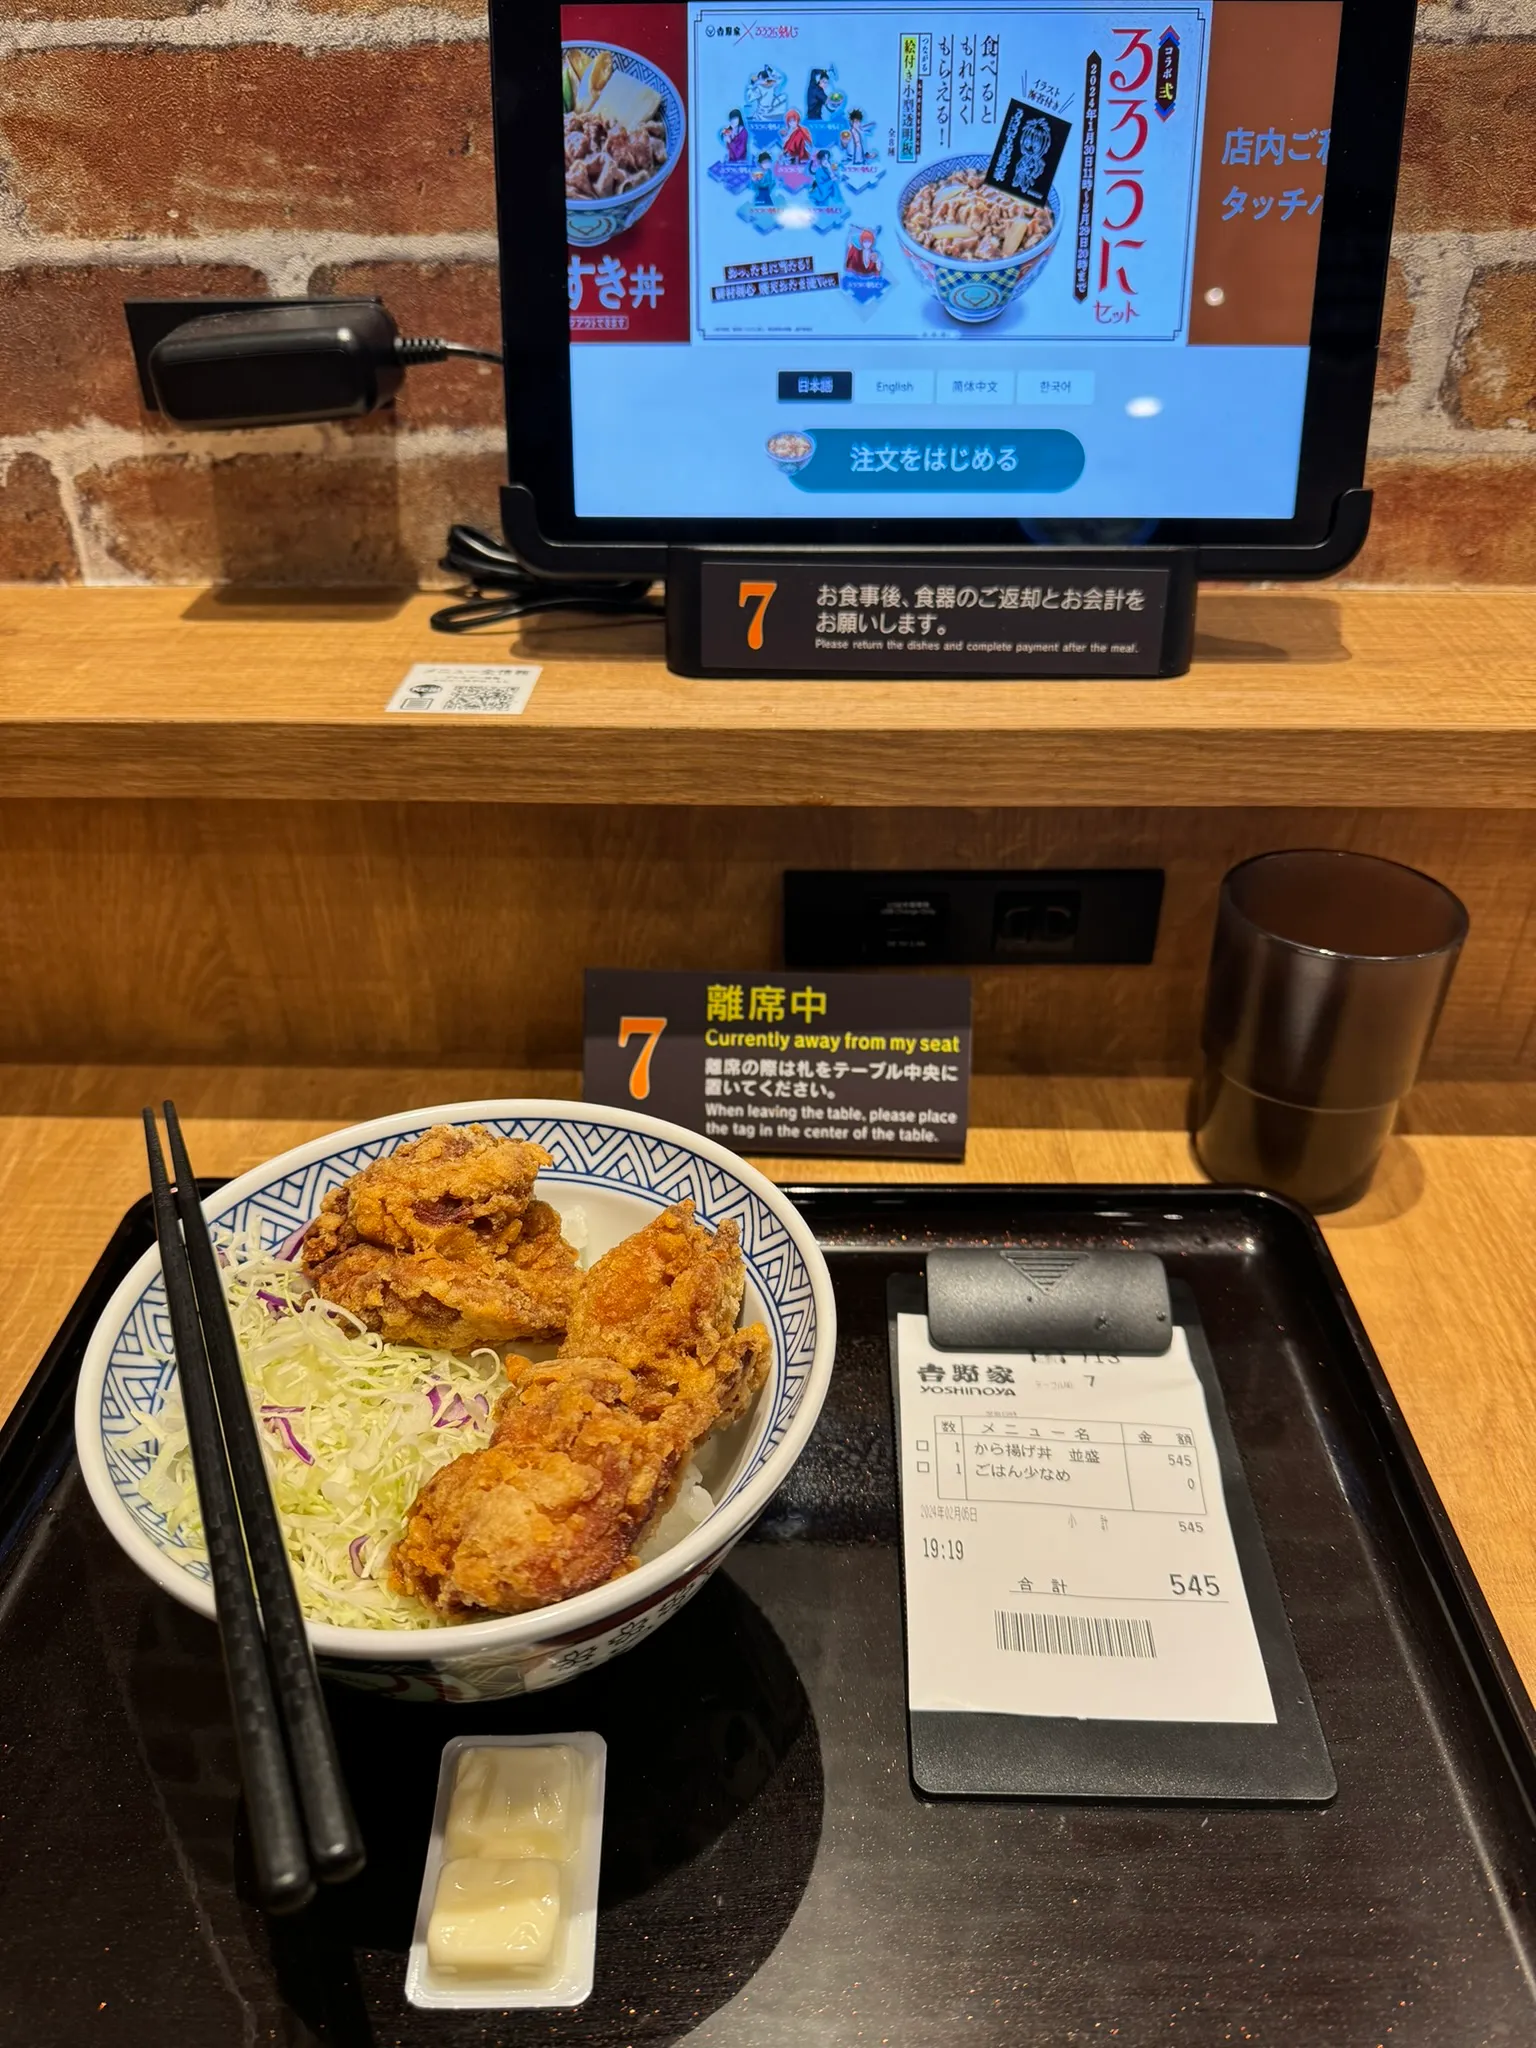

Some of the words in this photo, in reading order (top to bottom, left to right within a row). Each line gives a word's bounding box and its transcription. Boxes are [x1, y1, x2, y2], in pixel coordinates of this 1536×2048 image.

[798, 376, 833, 393] 日本語
[876, 382, 914, 395] English
[1040, 380, 1072, 394] 한국어
[850, 444, 1018, 473] 注文をはじめる
[816, 584, 1145, 611] お食事後、食器のご返却とお会計を
[738, 580, 778, 650] 7
[815, 612, 947, 635] お願いします。
[814, 637, 849, 649] Please
[852, 639, 883, 650] return
[887, 639, 904, 650] the
[907, 640, 940, 651] dishes
[943, 640, 963, 652] and
[966, 641, 1012, 653] complete
[1015, 643, 1060, 655] payment
[1062, 641, 1087, 653] after
[1090, 642, 1107, 654] the
[1110, 643, 1139, 655] meal.
[706, 984, 827, 1024] 離席中
[705, 1029, 791, 1051] Currently
[794, 1034, 841, 1053] away
[844, 1032, 886, 1050] from
[890, 1037, 916, 1055] my
[919, 1036, 960, 1053] seat
[618, 1016, 668, 1100] 7
[705, 1057, 959, 1082] 離席の際は札をテーブル中央に
[705, 1078, 836, 1100] 置いてください。
[705, 1103, 744, 1117] When
[747, 1104, 797, 1121] leaving
[801, 1105, 825, 1120] the
[869, 1107, 916, 1123] please
[918, 1109, 958, 1125] place
[705, 1121, 728, 1135] the
[732, 1123, 755, 1137] tag
[759, 1122, 773, 1136] in
[777, 1124, 800, 1138] the
[804, 1125, 849, 1140] center
[852, 1126, 868, 1140] of
[871, 1127, 896, 1141] the
[899, 1128, 939, 1143] table.
[1084, 1374, 1096, 1388] 7
[941, 1420, 956, 1433] 数
[954, 1441, 961, 1453] 1
[974, 1441, 1053, 1460] から揚げ丼
[1069, 1448, 1101, 1464] 並盛
[1167, 1453, 1193, 1467] 545
[955, 1463, 962, 1475] 1
[975, 1463, 1071, 1482] ごはん少なめ
[1187, 1478, 1195, 1490] 0
[1178, 1520, 1205, 1533] 545
[923, 1537, 964, 1560] 19:19
[1169, 1573, 1221, 1597] 545
